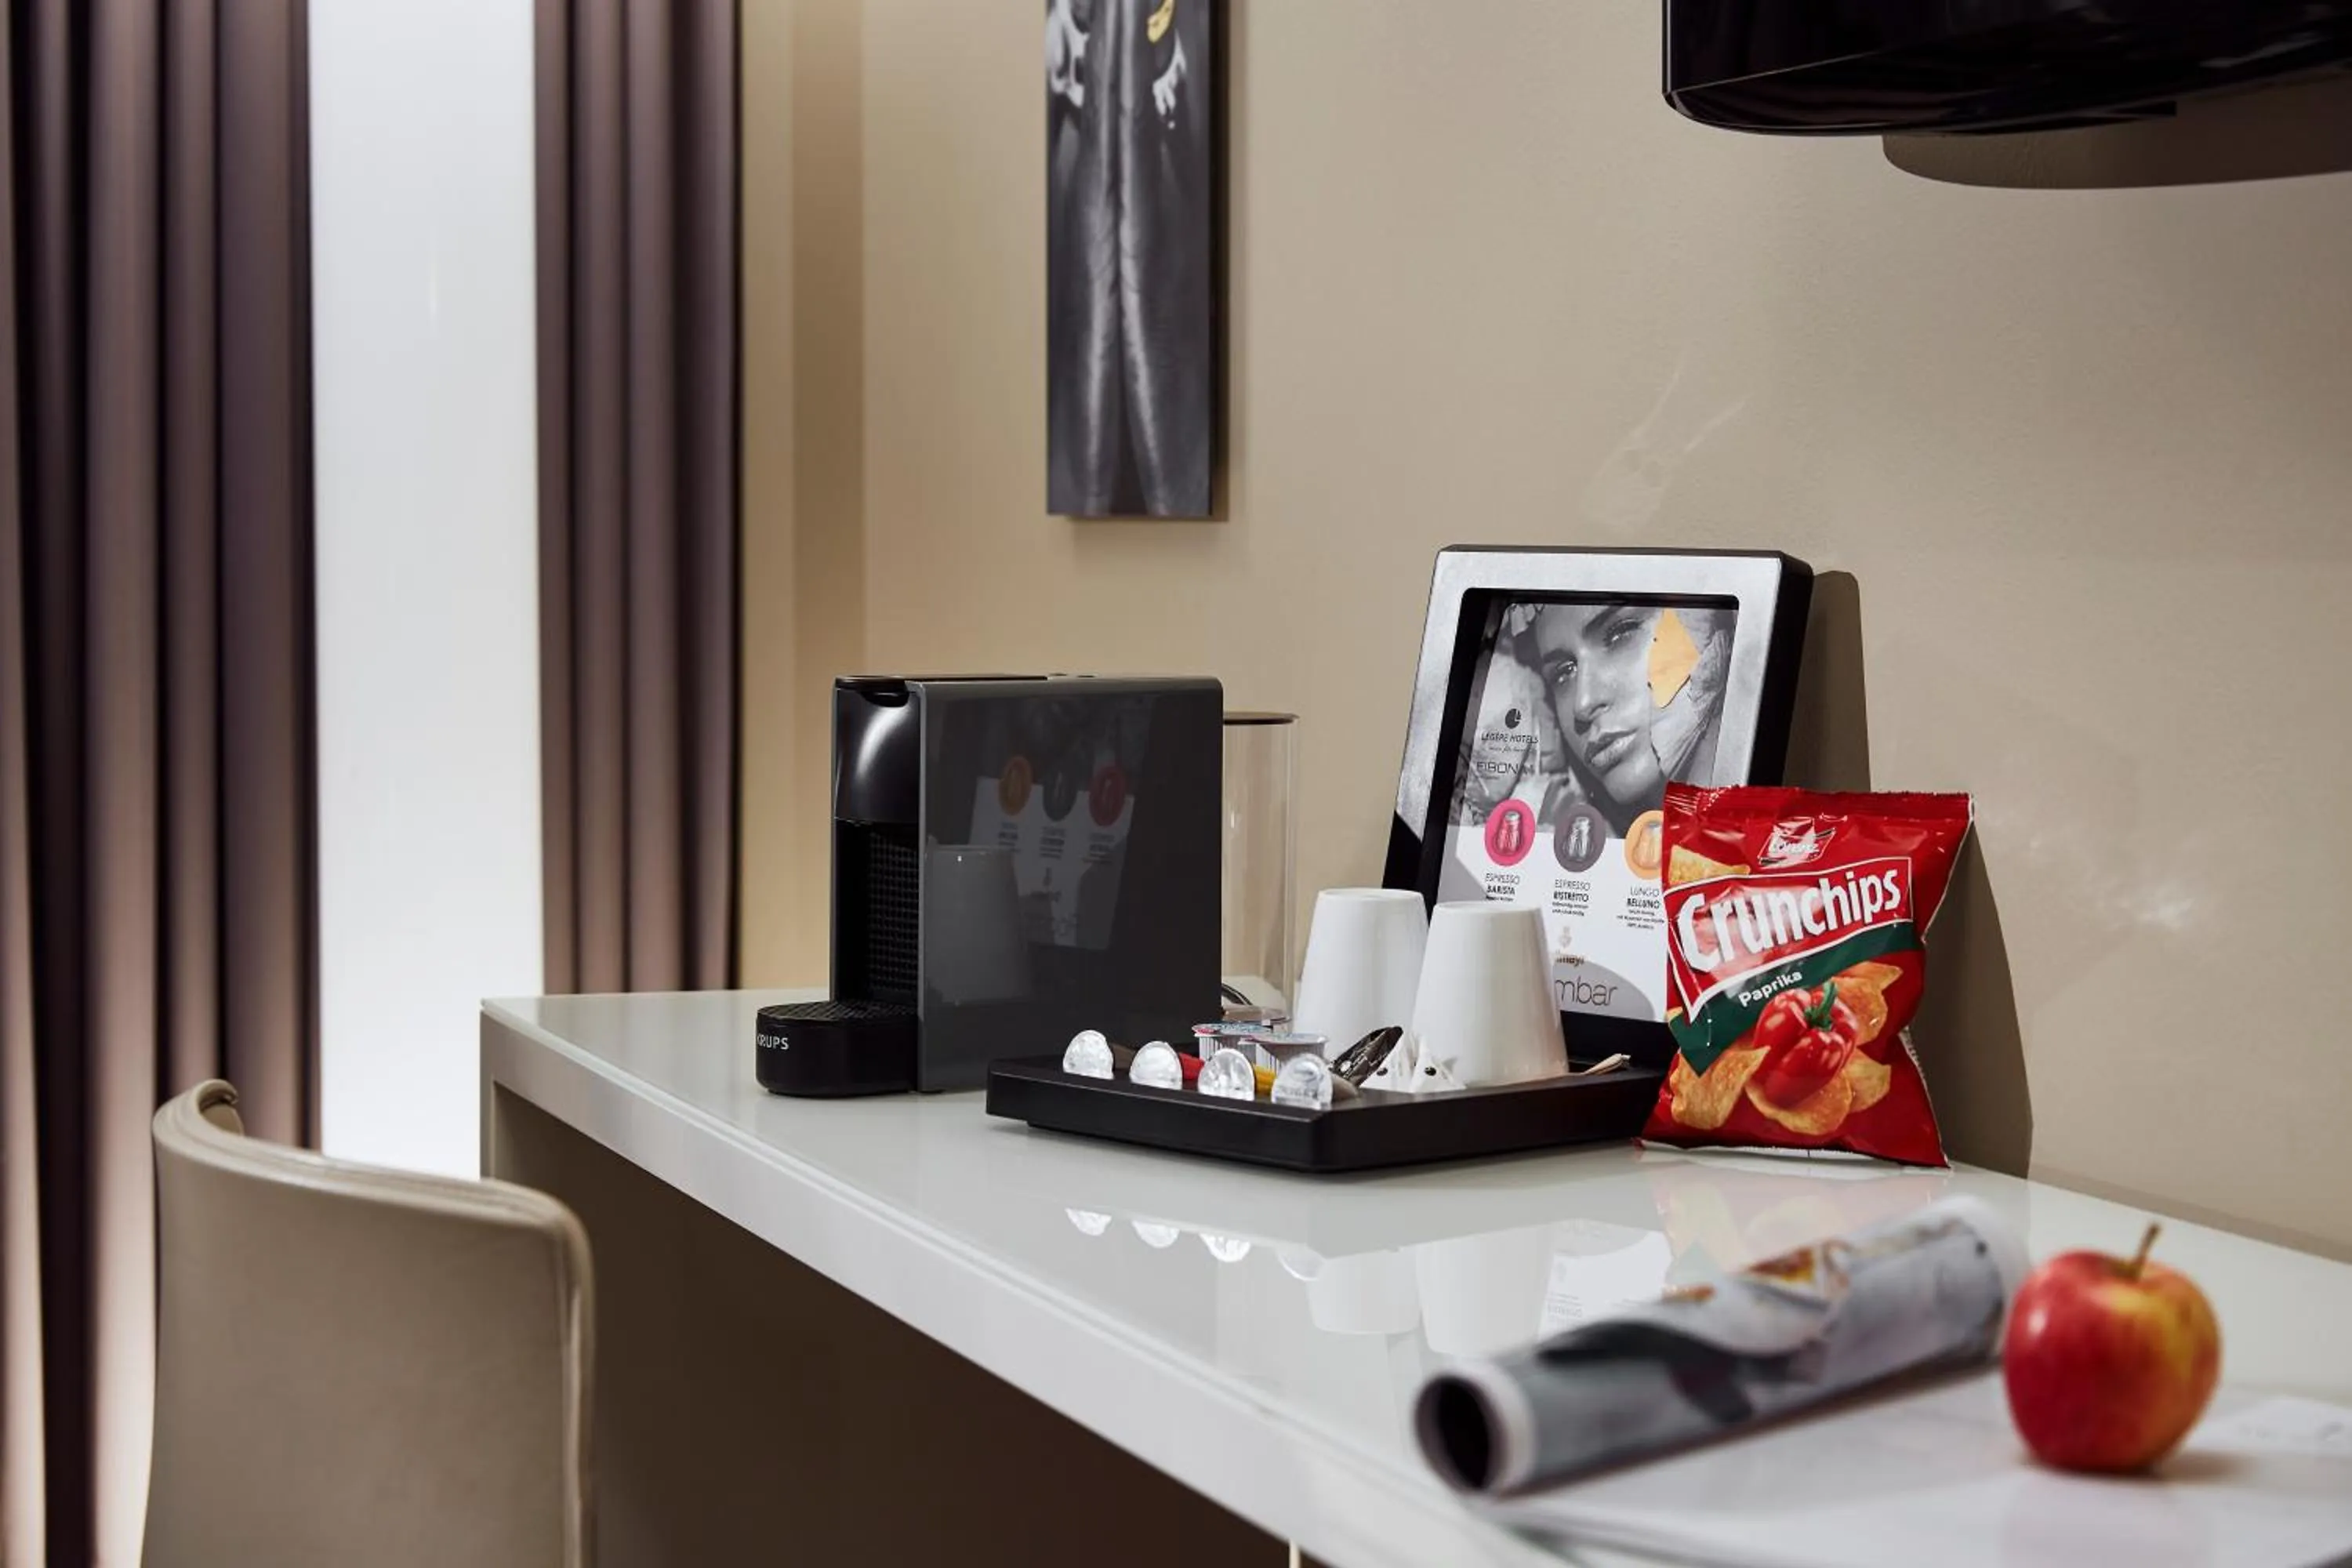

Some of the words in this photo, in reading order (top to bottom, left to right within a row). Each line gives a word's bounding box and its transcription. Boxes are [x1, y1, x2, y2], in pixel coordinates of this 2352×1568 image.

[1486, 873, 1520, 885] ESPRESSO
[1555, 879, 1591, 891] ESPRESSO
[1486, 885, 1515, 895] BARISTA
[1630, 886, 1660, 898] LUNGO
[1553, 891, 1589, 902] RISTRETTO
[1677, 869, 1901, 973] Crunchips
[1555, 975, 1618, 1007] mbar
[1738, 970, 1802, 1007] Paprika
